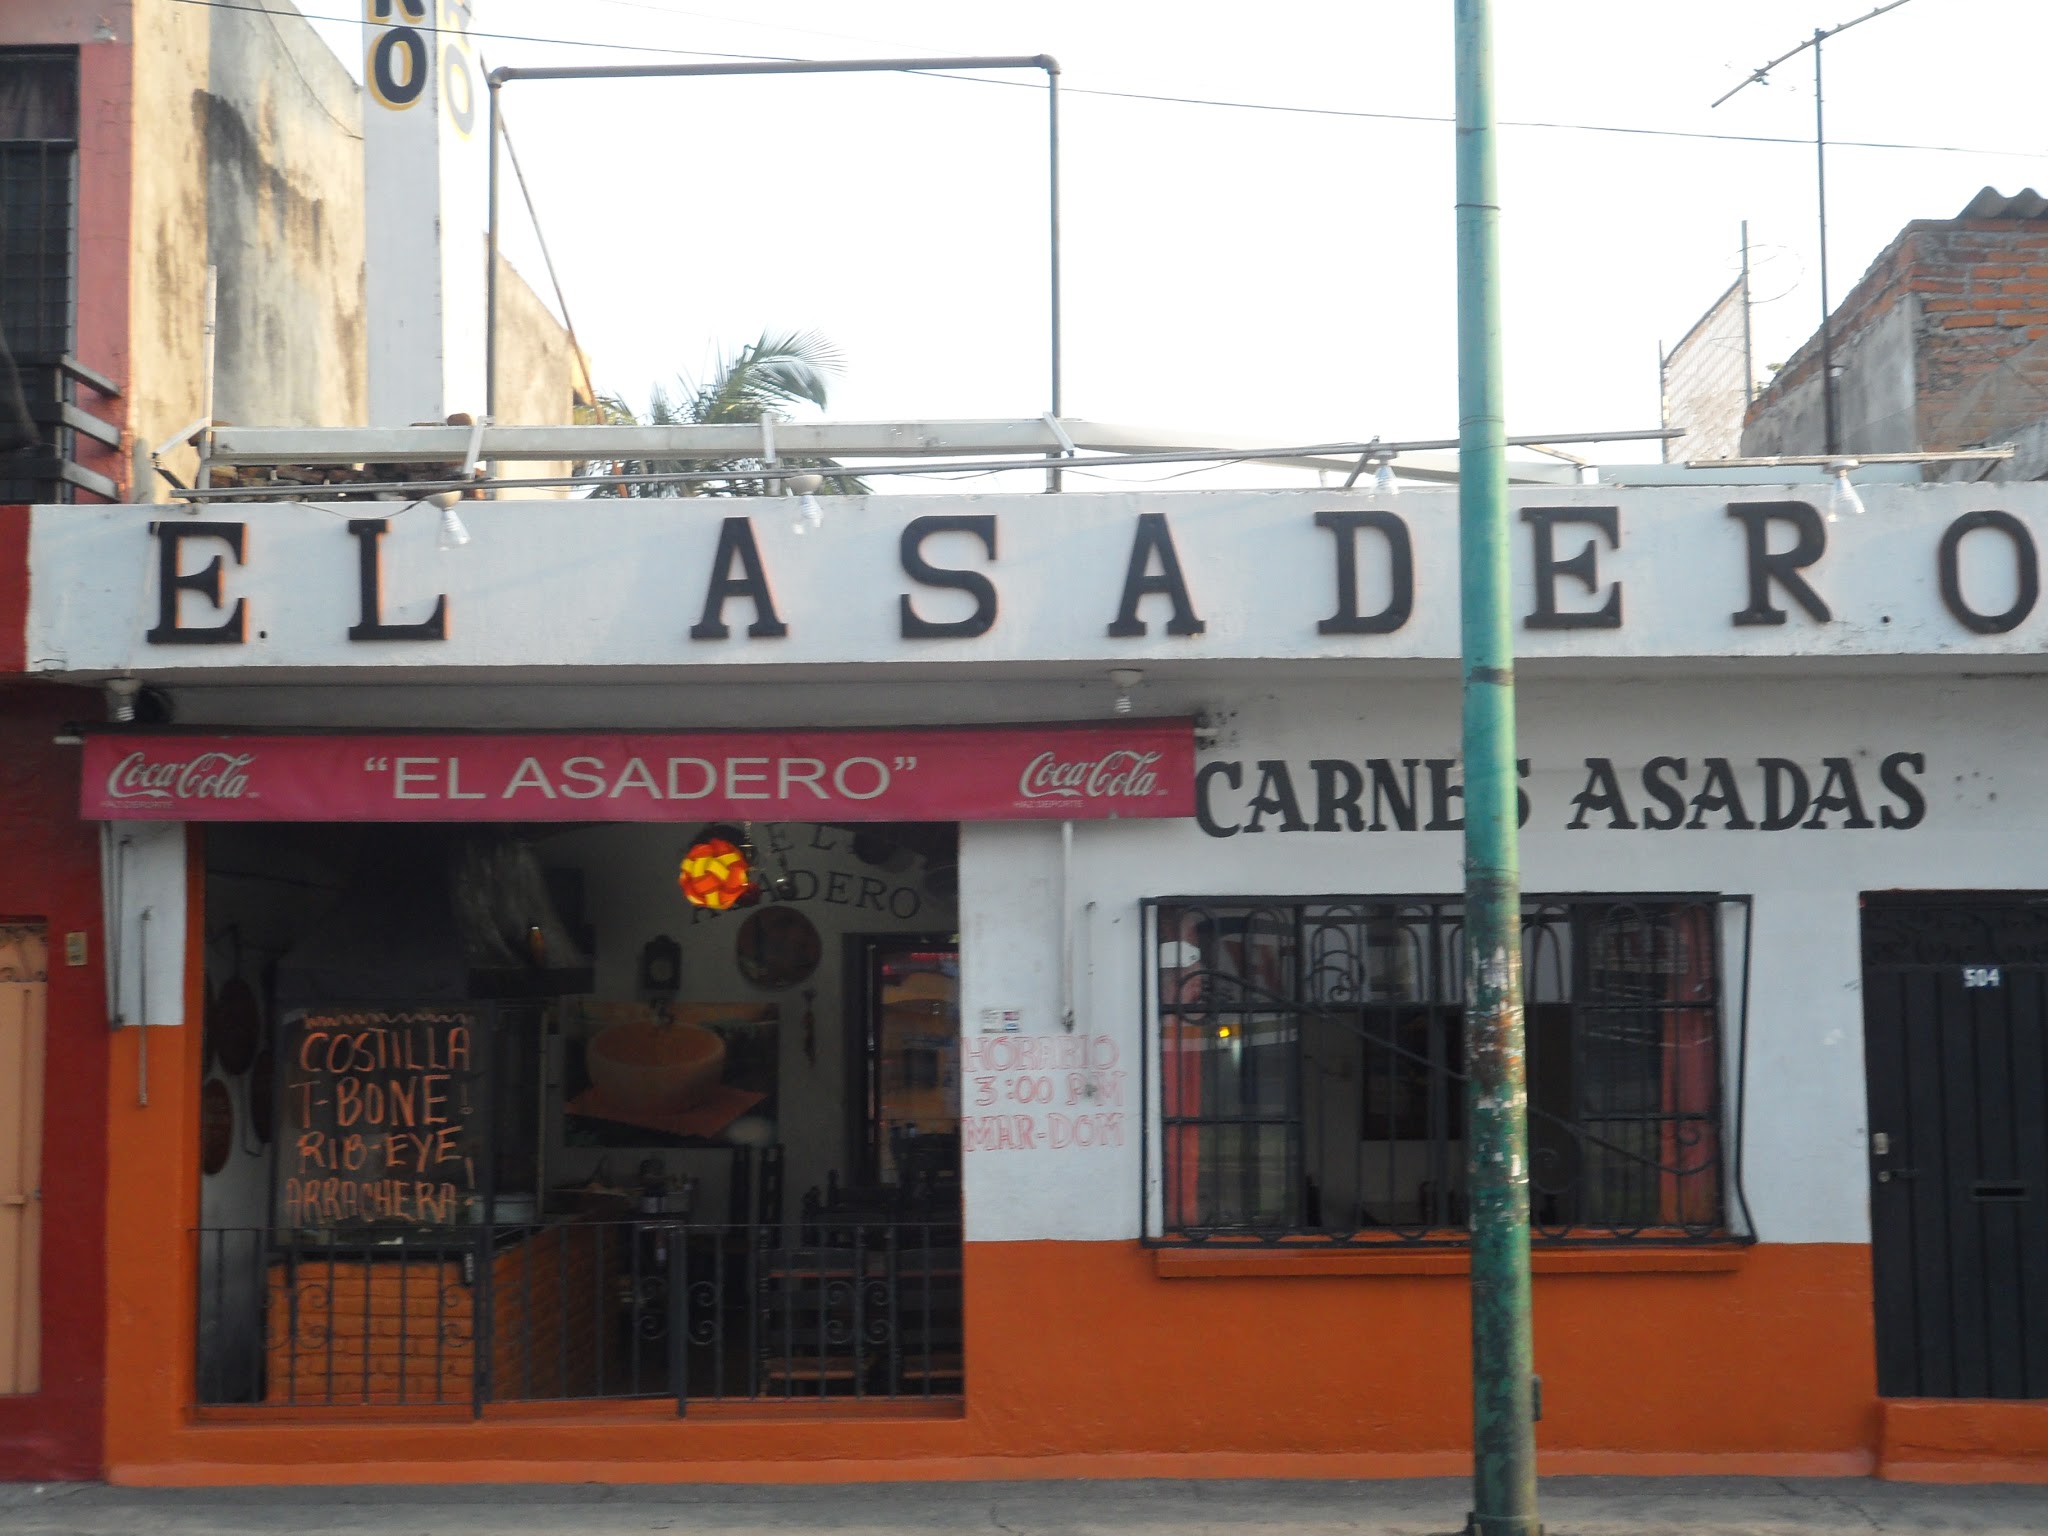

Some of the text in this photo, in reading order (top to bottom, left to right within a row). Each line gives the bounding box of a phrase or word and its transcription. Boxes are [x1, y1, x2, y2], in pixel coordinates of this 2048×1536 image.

[147, 500, 2040, 645] EL ASADERO
[1566, 751, 1926, 831] ASADAS
[1963, 968, 2000, 988] 504
[301, 1026, 472, 1074] COSTILLA
[973, 1074, 1054, 1107] 3:00
[960, 1111, 1125, 1152] MAR-DOM
